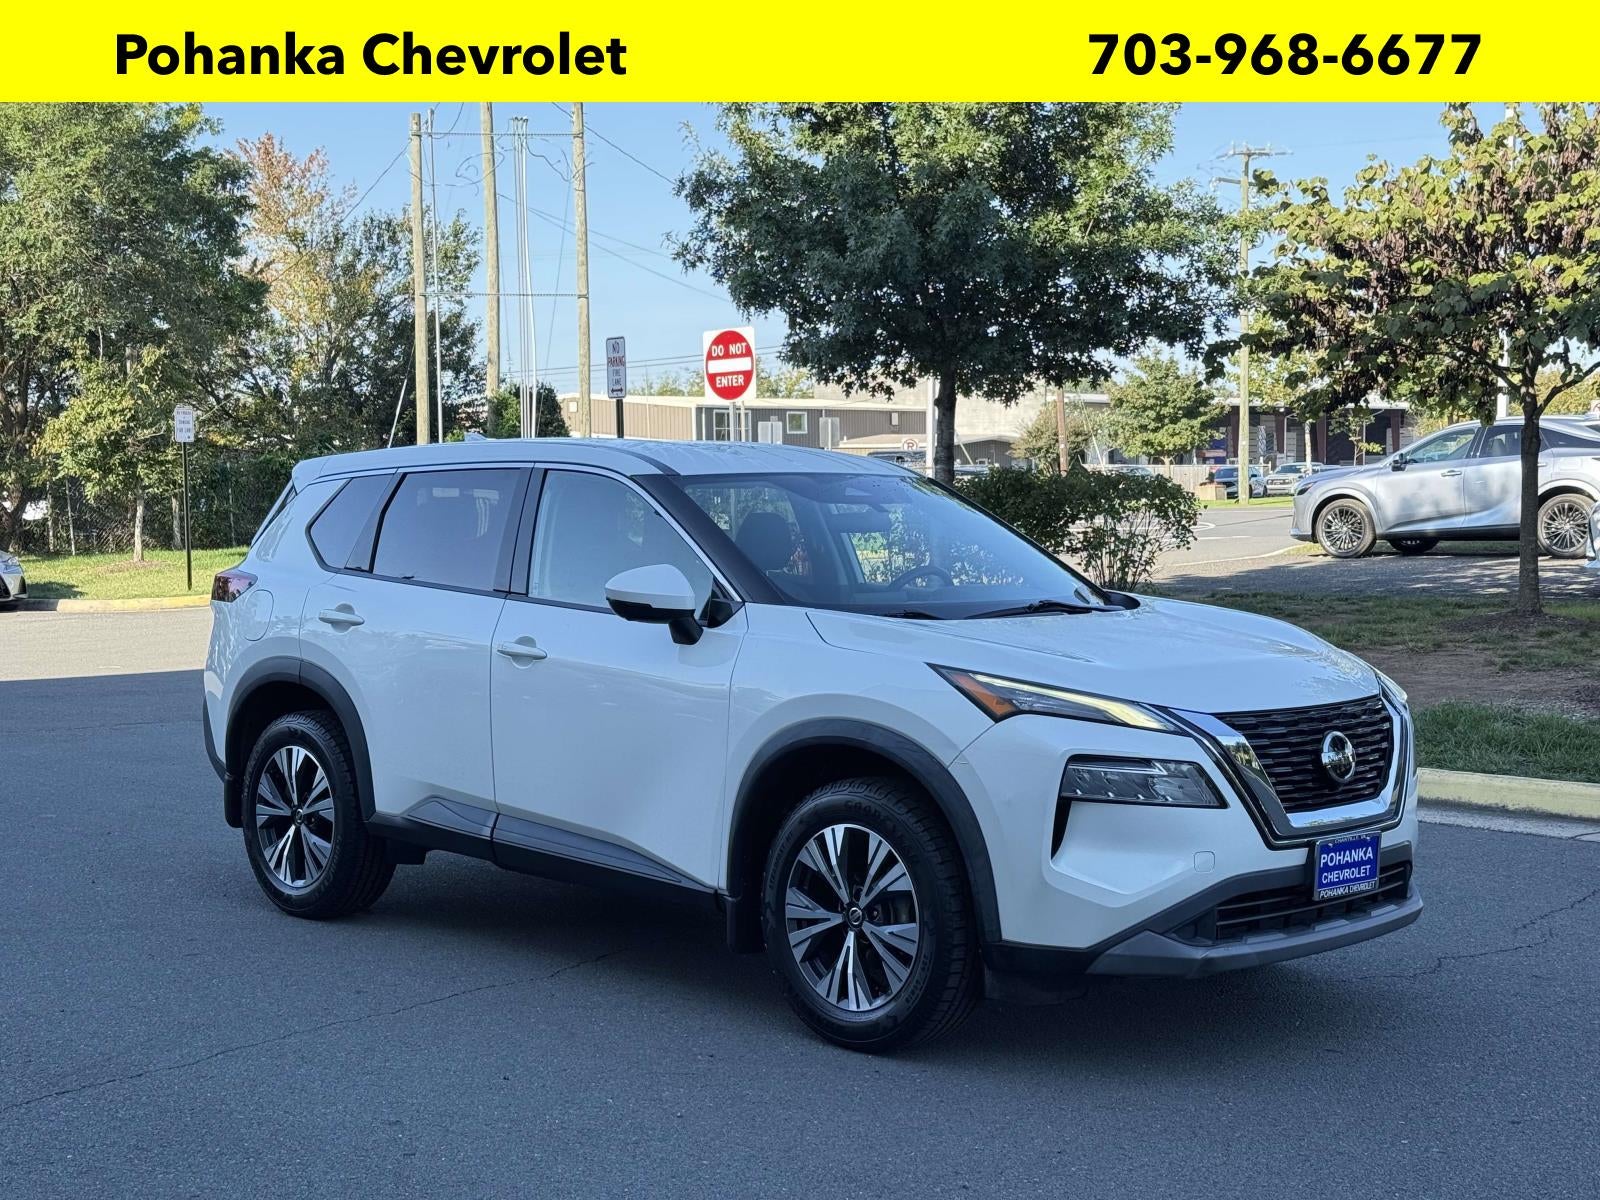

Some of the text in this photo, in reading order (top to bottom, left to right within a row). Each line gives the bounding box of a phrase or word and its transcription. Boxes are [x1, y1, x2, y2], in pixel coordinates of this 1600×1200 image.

[612, 341, 620, 354] NO
[712, 342, 747, 357] DO NOT
[608, 356, 625, 367] PARKING
[716, 375, 744, 388] ENTER
[1320, 846, 1373, 868] POHANKA
[1321, 865, 1371, 884] CHEVROLET
[1319, 881, 1376, 899] POHANKA CHEVROLET
